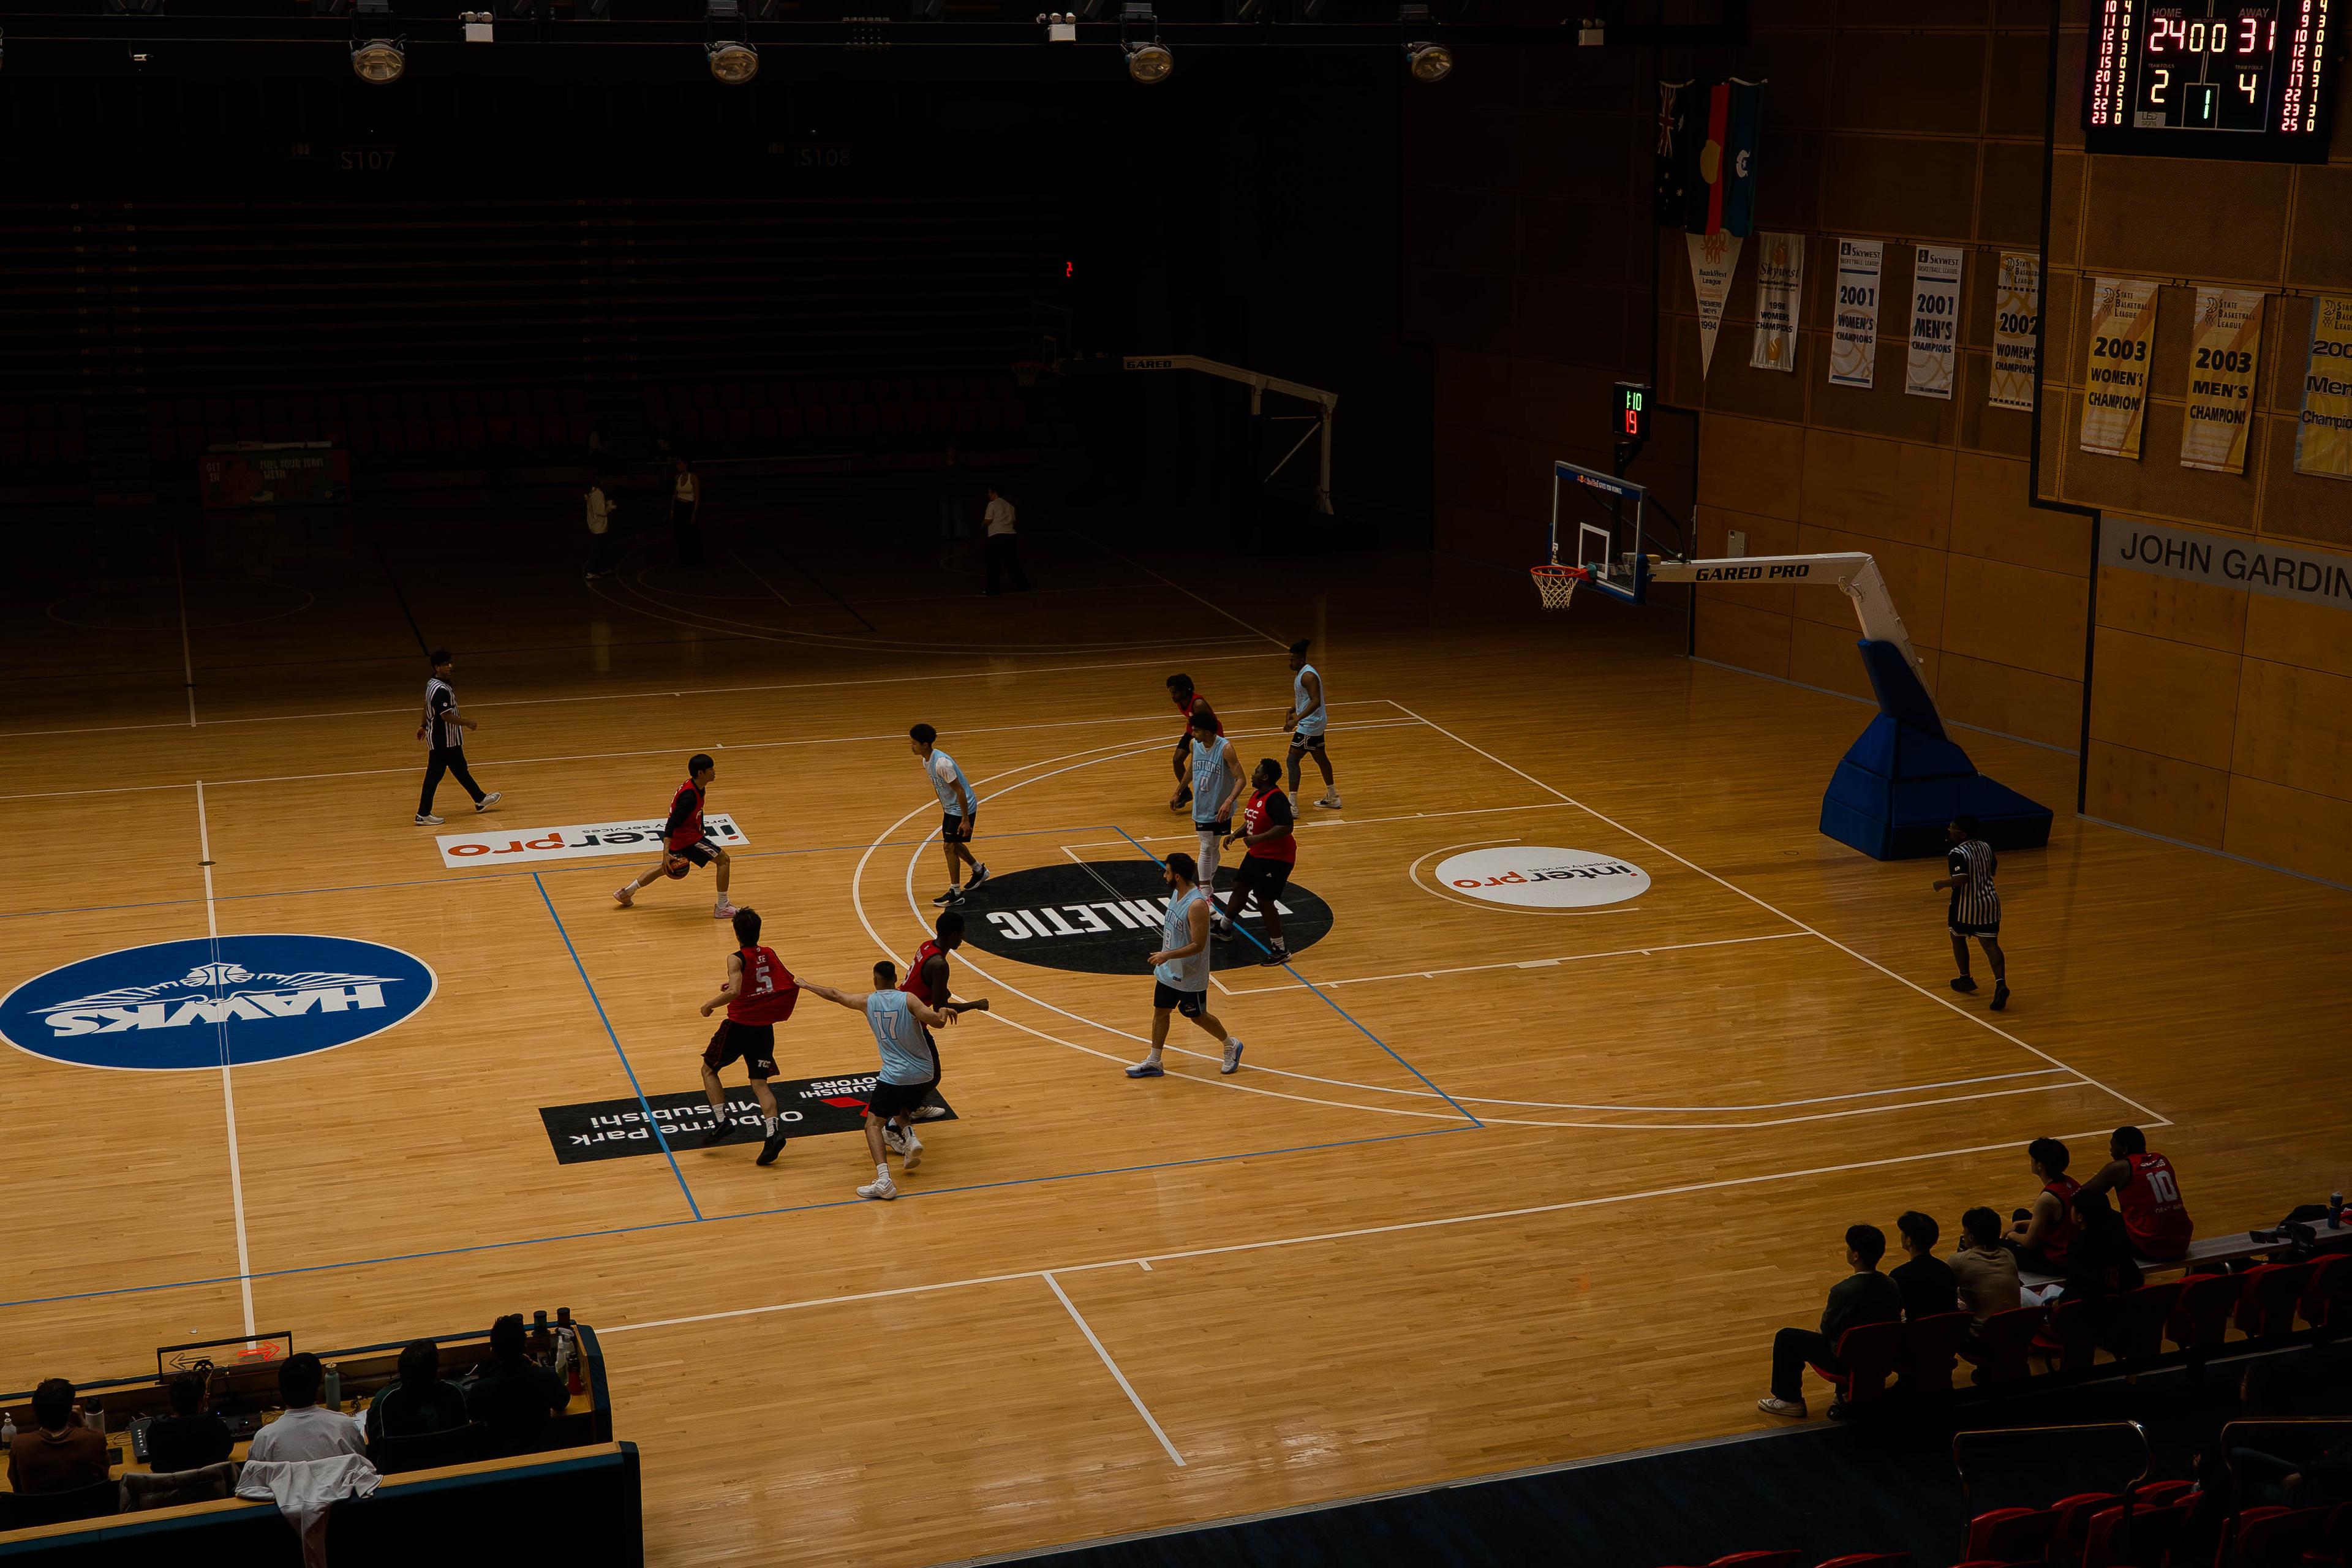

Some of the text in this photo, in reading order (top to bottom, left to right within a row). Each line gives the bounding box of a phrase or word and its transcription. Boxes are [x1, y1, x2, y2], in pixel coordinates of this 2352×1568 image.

[2105, 1, 2132, 13] 10 4
[2152, 7, 2182, 18] HOME
[2237, 7, 2270, 18] AWAY
[2302, 0, 2328, 13] 8 4
[2104, 14, 2130, 27] 11 0
[2301, 14, 2326, 28] 9 3
[2102, 28, 2129, 41] 12 0
[2149, 18, 2186, 52] 24
[2188, 23, 2206, 53] 0
[2211, 23, 2228, 53] 0
[2239, 18, 2276, 53] 31
[2294, 29, 2324, 43] 10 0
[2101, 42, 2128, 55] 13 3
[2293, 44, 2323, 58] 12 0
[2100, 56, 2127, 69] 15 0
[2291, 59, 2321, 73] 15 0
[2095, 70, 2125, 83] 20 3
[2290, 74, 2320, 87] 17 3
[2094, 84, 2124, 97] 21 2
[2150, 69, 2169, 104] 2
[2238, 74, 2257, 104] 4
[2284, 88, 2318, 102] 22 1
[2093, 98, 2123, 111] 22 3
[2203, 89, 2211, 119] 1
[2283, 103, 2316, 118] 23 3
[2092, 111, 2122, 124] 23 0
[2281, 118, 2315, 132] 25 0
[341, 150, 397, 171] S107
[801, 148, 851, 167] S108
[1839, 285, 1875, 307] 2001
[1917, 293, 1954, 315] 2001
[1701, 320, 1717, 330] 1994
[1838, 314, 1874, 331] WOMEN'S
[1913, 318, 1953, 340] MEN'S
[1999, 312, 2039, 335] 2002
[1836, 331, 1873, 344] CHAMPIONS
[1912, 341, 1951, 353] CHAMPIONS
[2094, 336, 2147, 361] 2003
[1126, 360, 1172, 369] GARED
[2195, 347, 2252, 374] 2003
[2090, 367, 2144, 388] WOMEN'S
[2192, 380, 2249, 400] MEN'S
[1625, 409, 1638, 435] 19
[2120, 532, 2212, 574] JOHN
[1695, 564, 1810, 581] GARED PRO
[581, 824, 651, 834] services
[1572, 860, 1619, 869] property
[755, 965, 775, 994] 5
[43, 983, 387, 1038] HAWKS
[873, 1009, 901, 1041] 17
[568, 1127, 650, 1146] Park
[2146, 1170, 2179, 1204] 10
